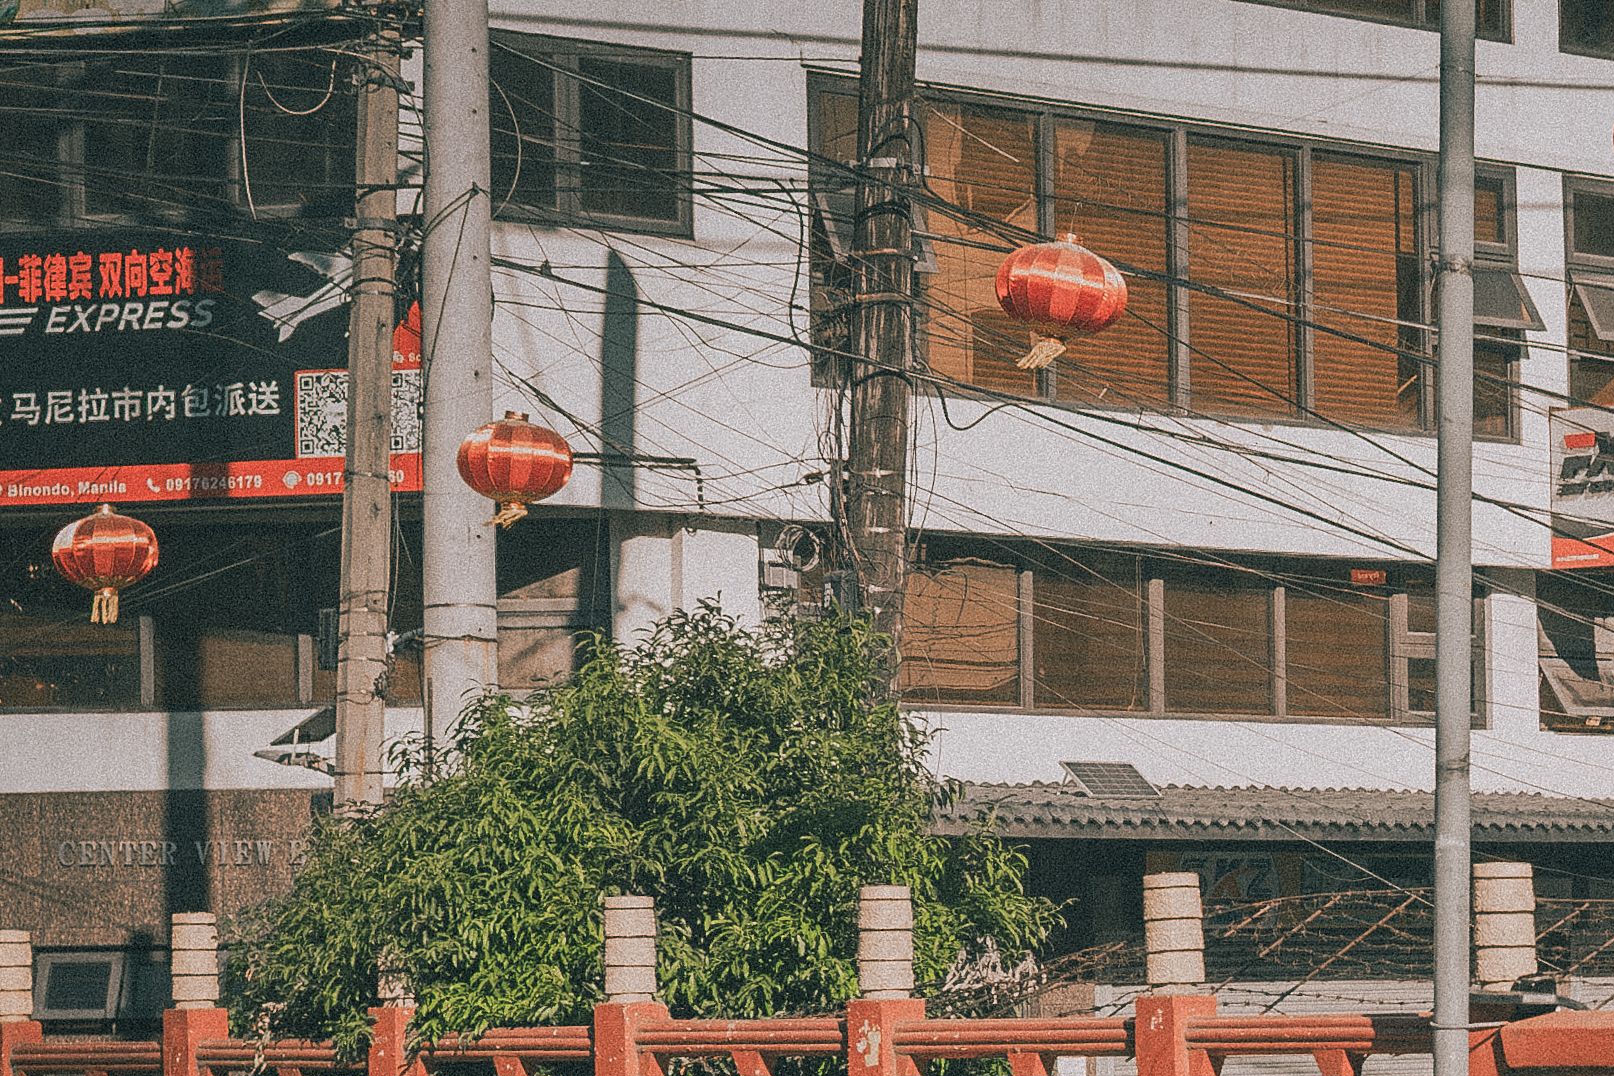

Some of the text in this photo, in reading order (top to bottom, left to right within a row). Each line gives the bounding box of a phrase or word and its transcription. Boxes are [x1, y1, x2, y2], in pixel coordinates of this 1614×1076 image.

[0, 253, 93, 303] -菲律宾
[45, 300, 216, 334] EXPRESS
[0, 380, 281, 426] 马尼拉市内包派送
[7, 480, 127, 498] Binondo, Manila
[59, 841, 178, 868] CENTER
[195, 841, 273, 867] VIEW
